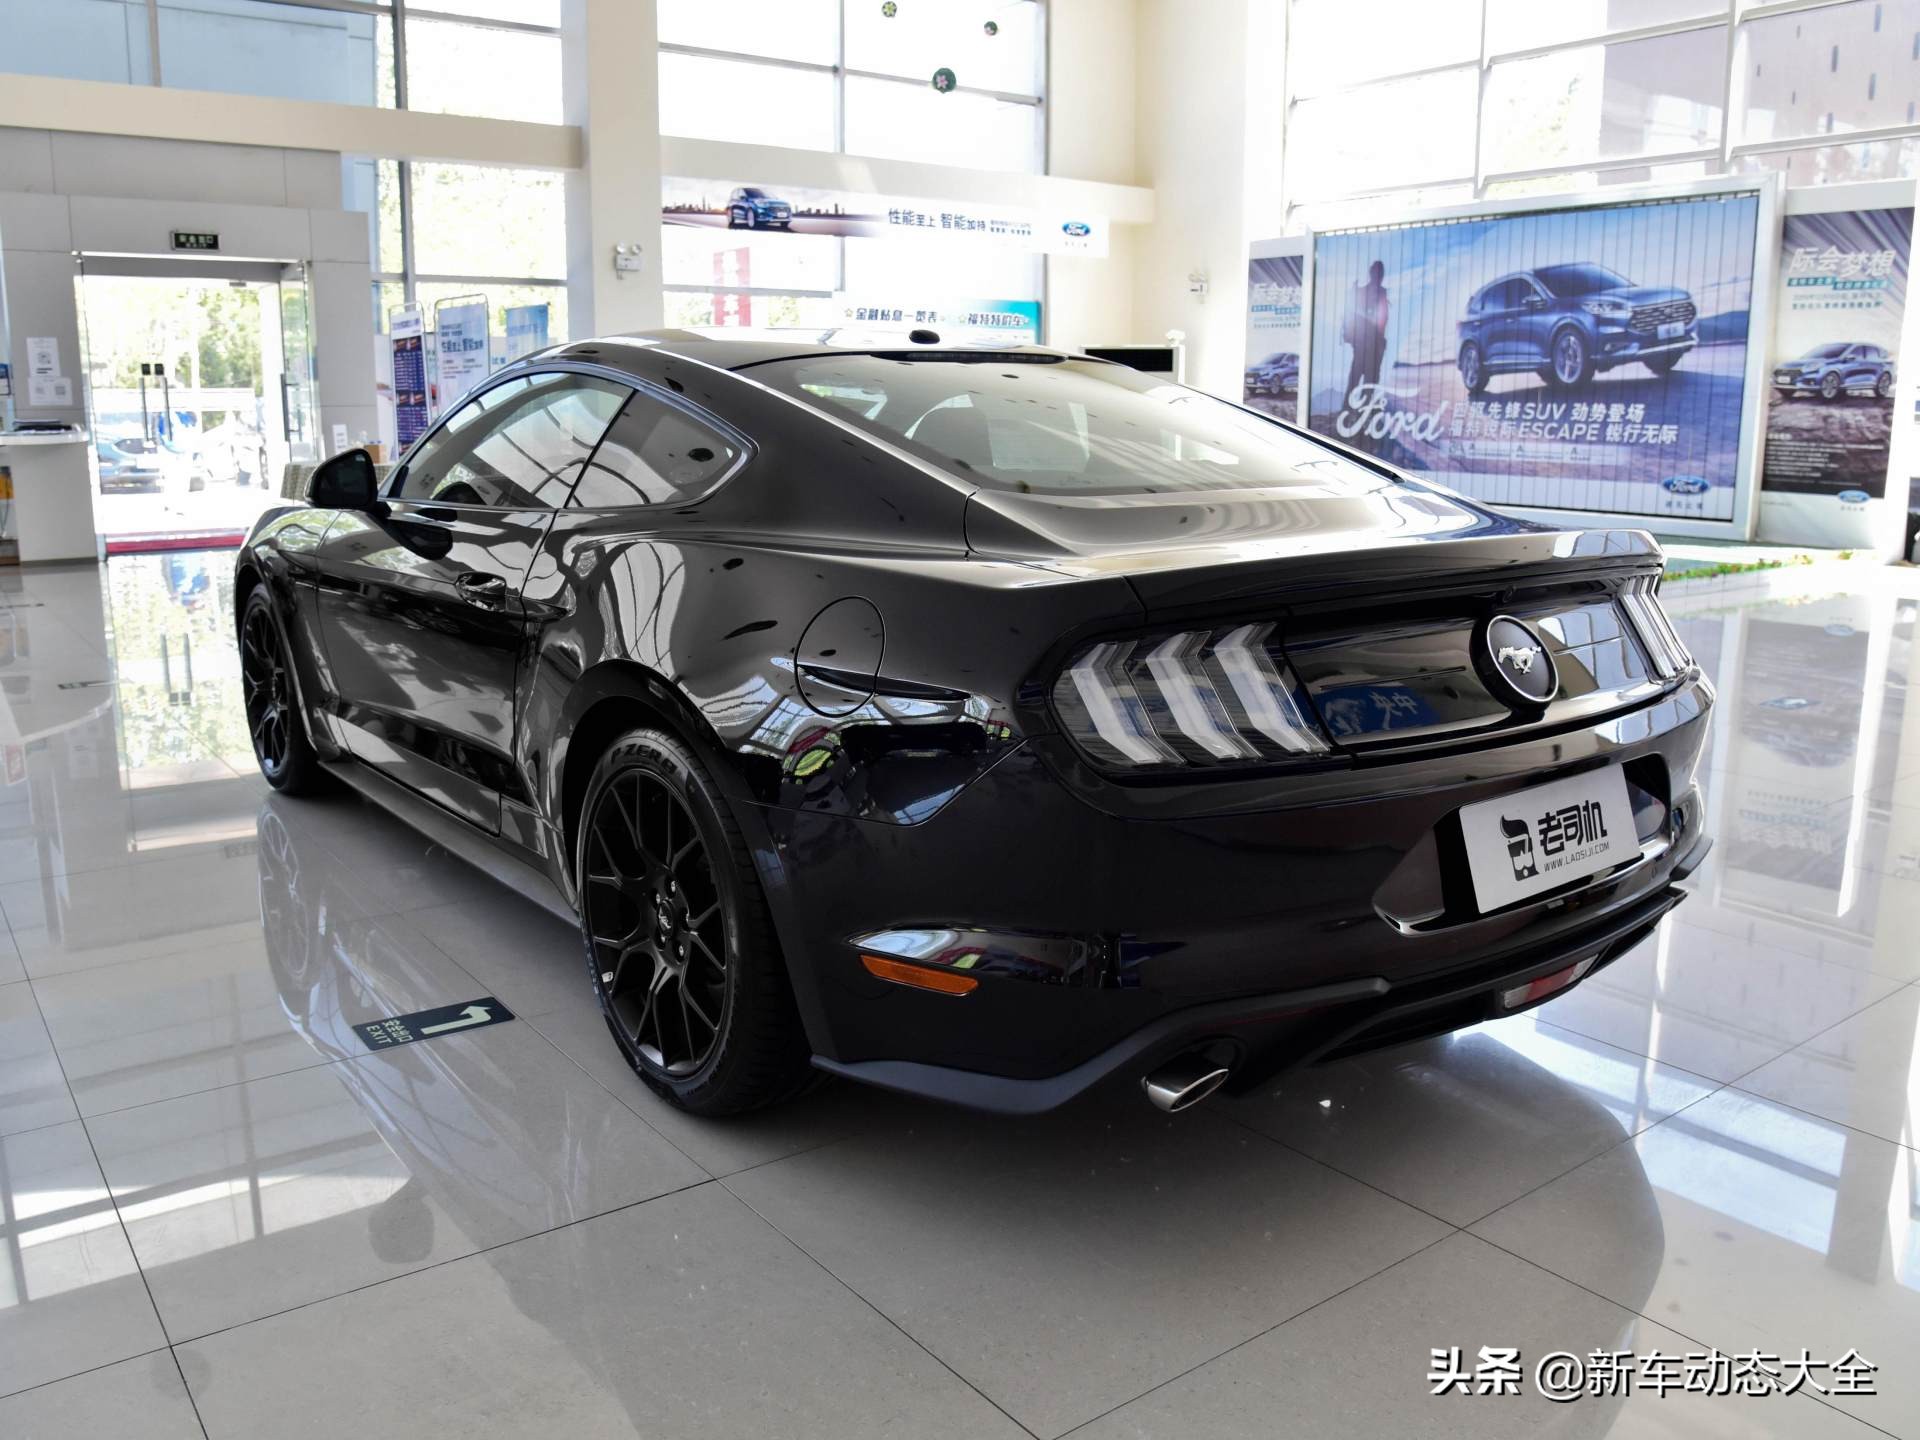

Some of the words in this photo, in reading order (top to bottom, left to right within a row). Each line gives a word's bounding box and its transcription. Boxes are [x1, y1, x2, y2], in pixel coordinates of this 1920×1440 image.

[889, 208, 936, 228] 性能至上
[941, 213, 986, 231] 智能加持
[1788, 245, 1896, 277] 际会梦想
[1336, 375, 1450, 442] Ford
[1570, 402, 1646, 423] 劲势登场
[1605, 424, 1679, 444] 锐行无际
[1537, 800, 1608, 857] 老司机
[1543, 842, 1610, 873] WWW.LAOSIJI.COM
[366, 1024, 393, 1044] EXIT
